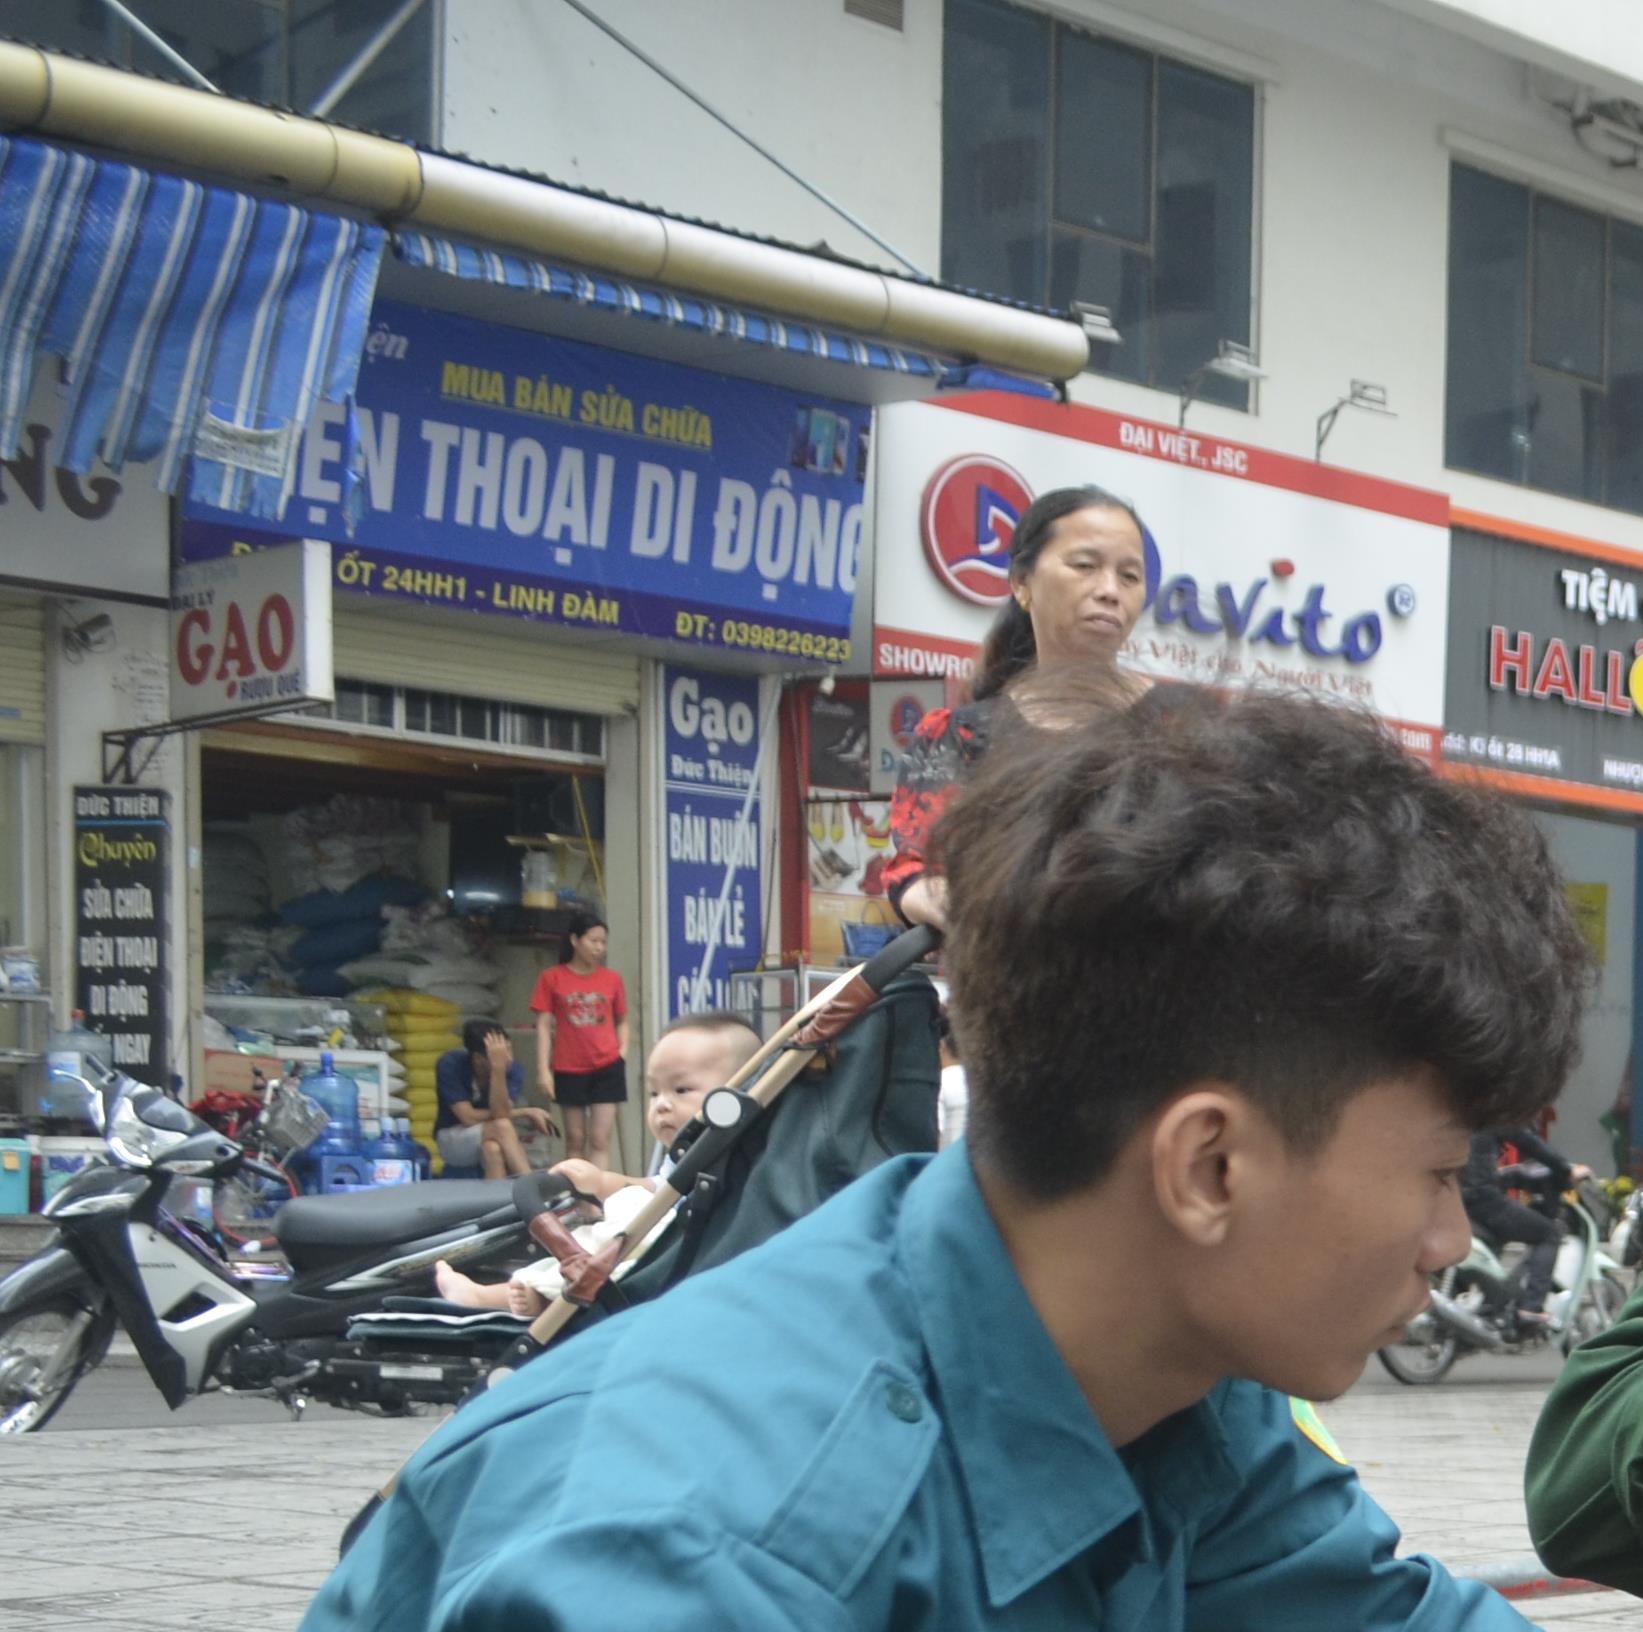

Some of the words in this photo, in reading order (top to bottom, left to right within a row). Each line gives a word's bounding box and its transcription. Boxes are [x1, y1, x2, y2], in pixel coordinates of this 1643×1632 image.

[442, 360, 505, 406] MUA
[514, 374, 572, 420] BÁN
[580, 383, 634, 430] SỬA
[642, 402, 713, 448] CHỮA
[1119, 421, 1156, 456] ĐẠI
[1211, 449, 1249, 475] JSC
[420, 418, 615, 565] THOẠI
[630, 461, 698, 565] DI
[711, 468, 866, 602] ĐỘNG
[382, 565, 467, 600] 24HH1
[492, 581, 555, 615] LINH
[562, 588, 620, 625] ĐÀM
[675, 611, 717, 639] ĐT:
[1143, 518, 1384, 665] avito
[1560, 567, 1638, 625] TIỆM
[177, 592, 295, 699] GẠO
[879, 643, 976, 680] SHOWRO
[669, 676, 755, 755] Gạo
